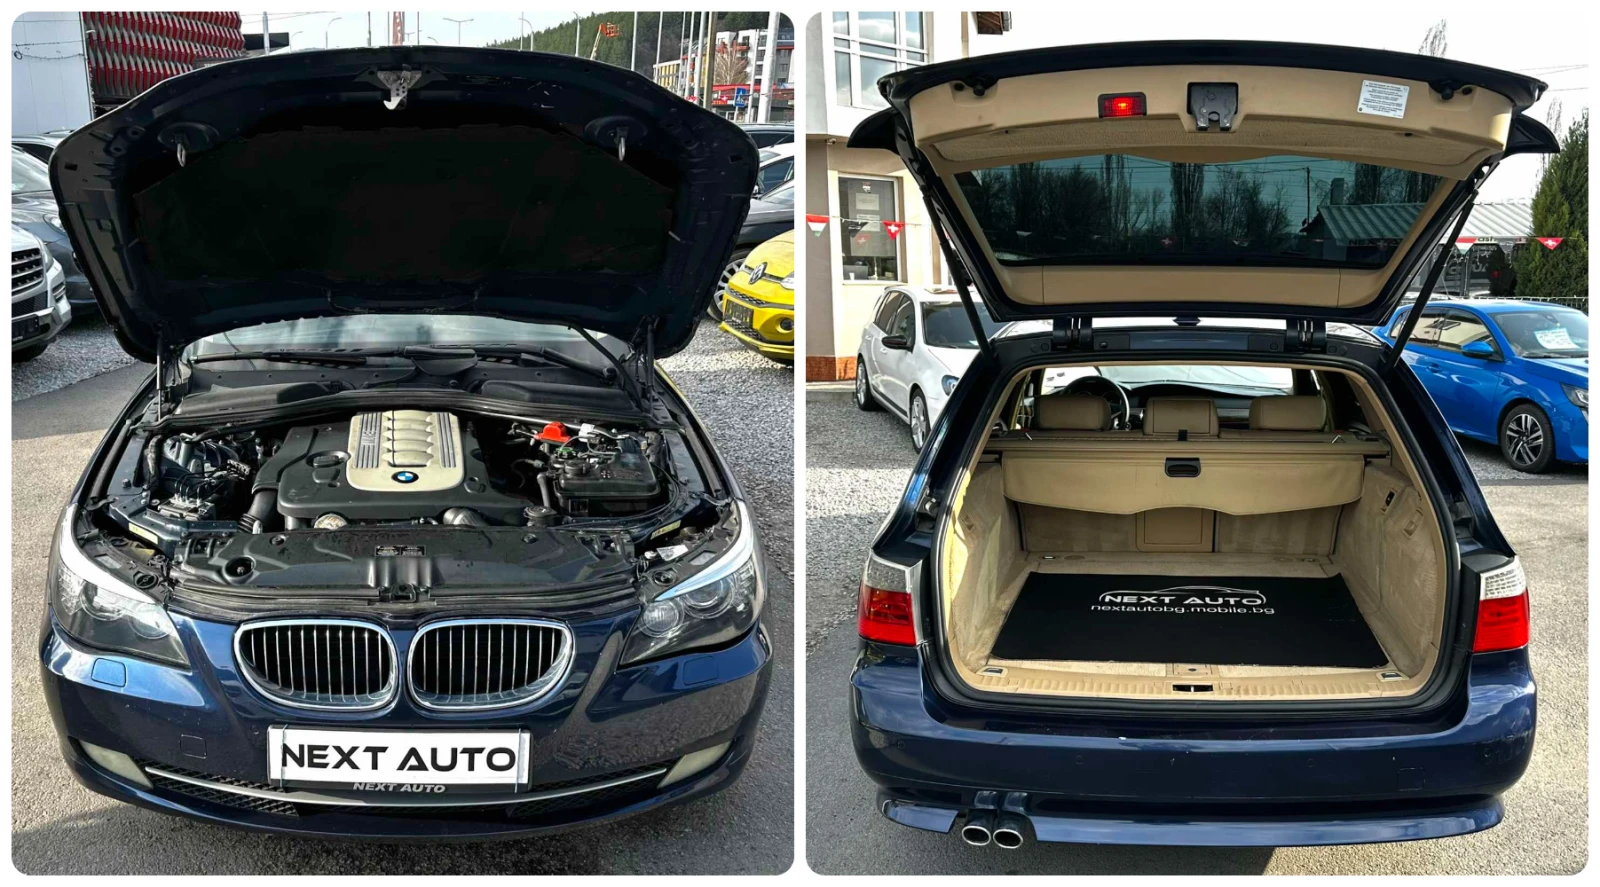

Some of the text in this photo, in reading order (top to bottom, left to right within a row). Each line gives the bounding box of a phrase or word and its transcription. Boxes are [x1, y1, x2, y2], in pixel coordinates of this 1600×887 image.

[1104, 595, 1262, 605] NEXT AUTO
[1091, 605, 1275, 615] nextautobg.mobile.bg
[281, 743, 516, 773] NEXT AUTO
[353, 782, 446, 794] NEXT AUTO
